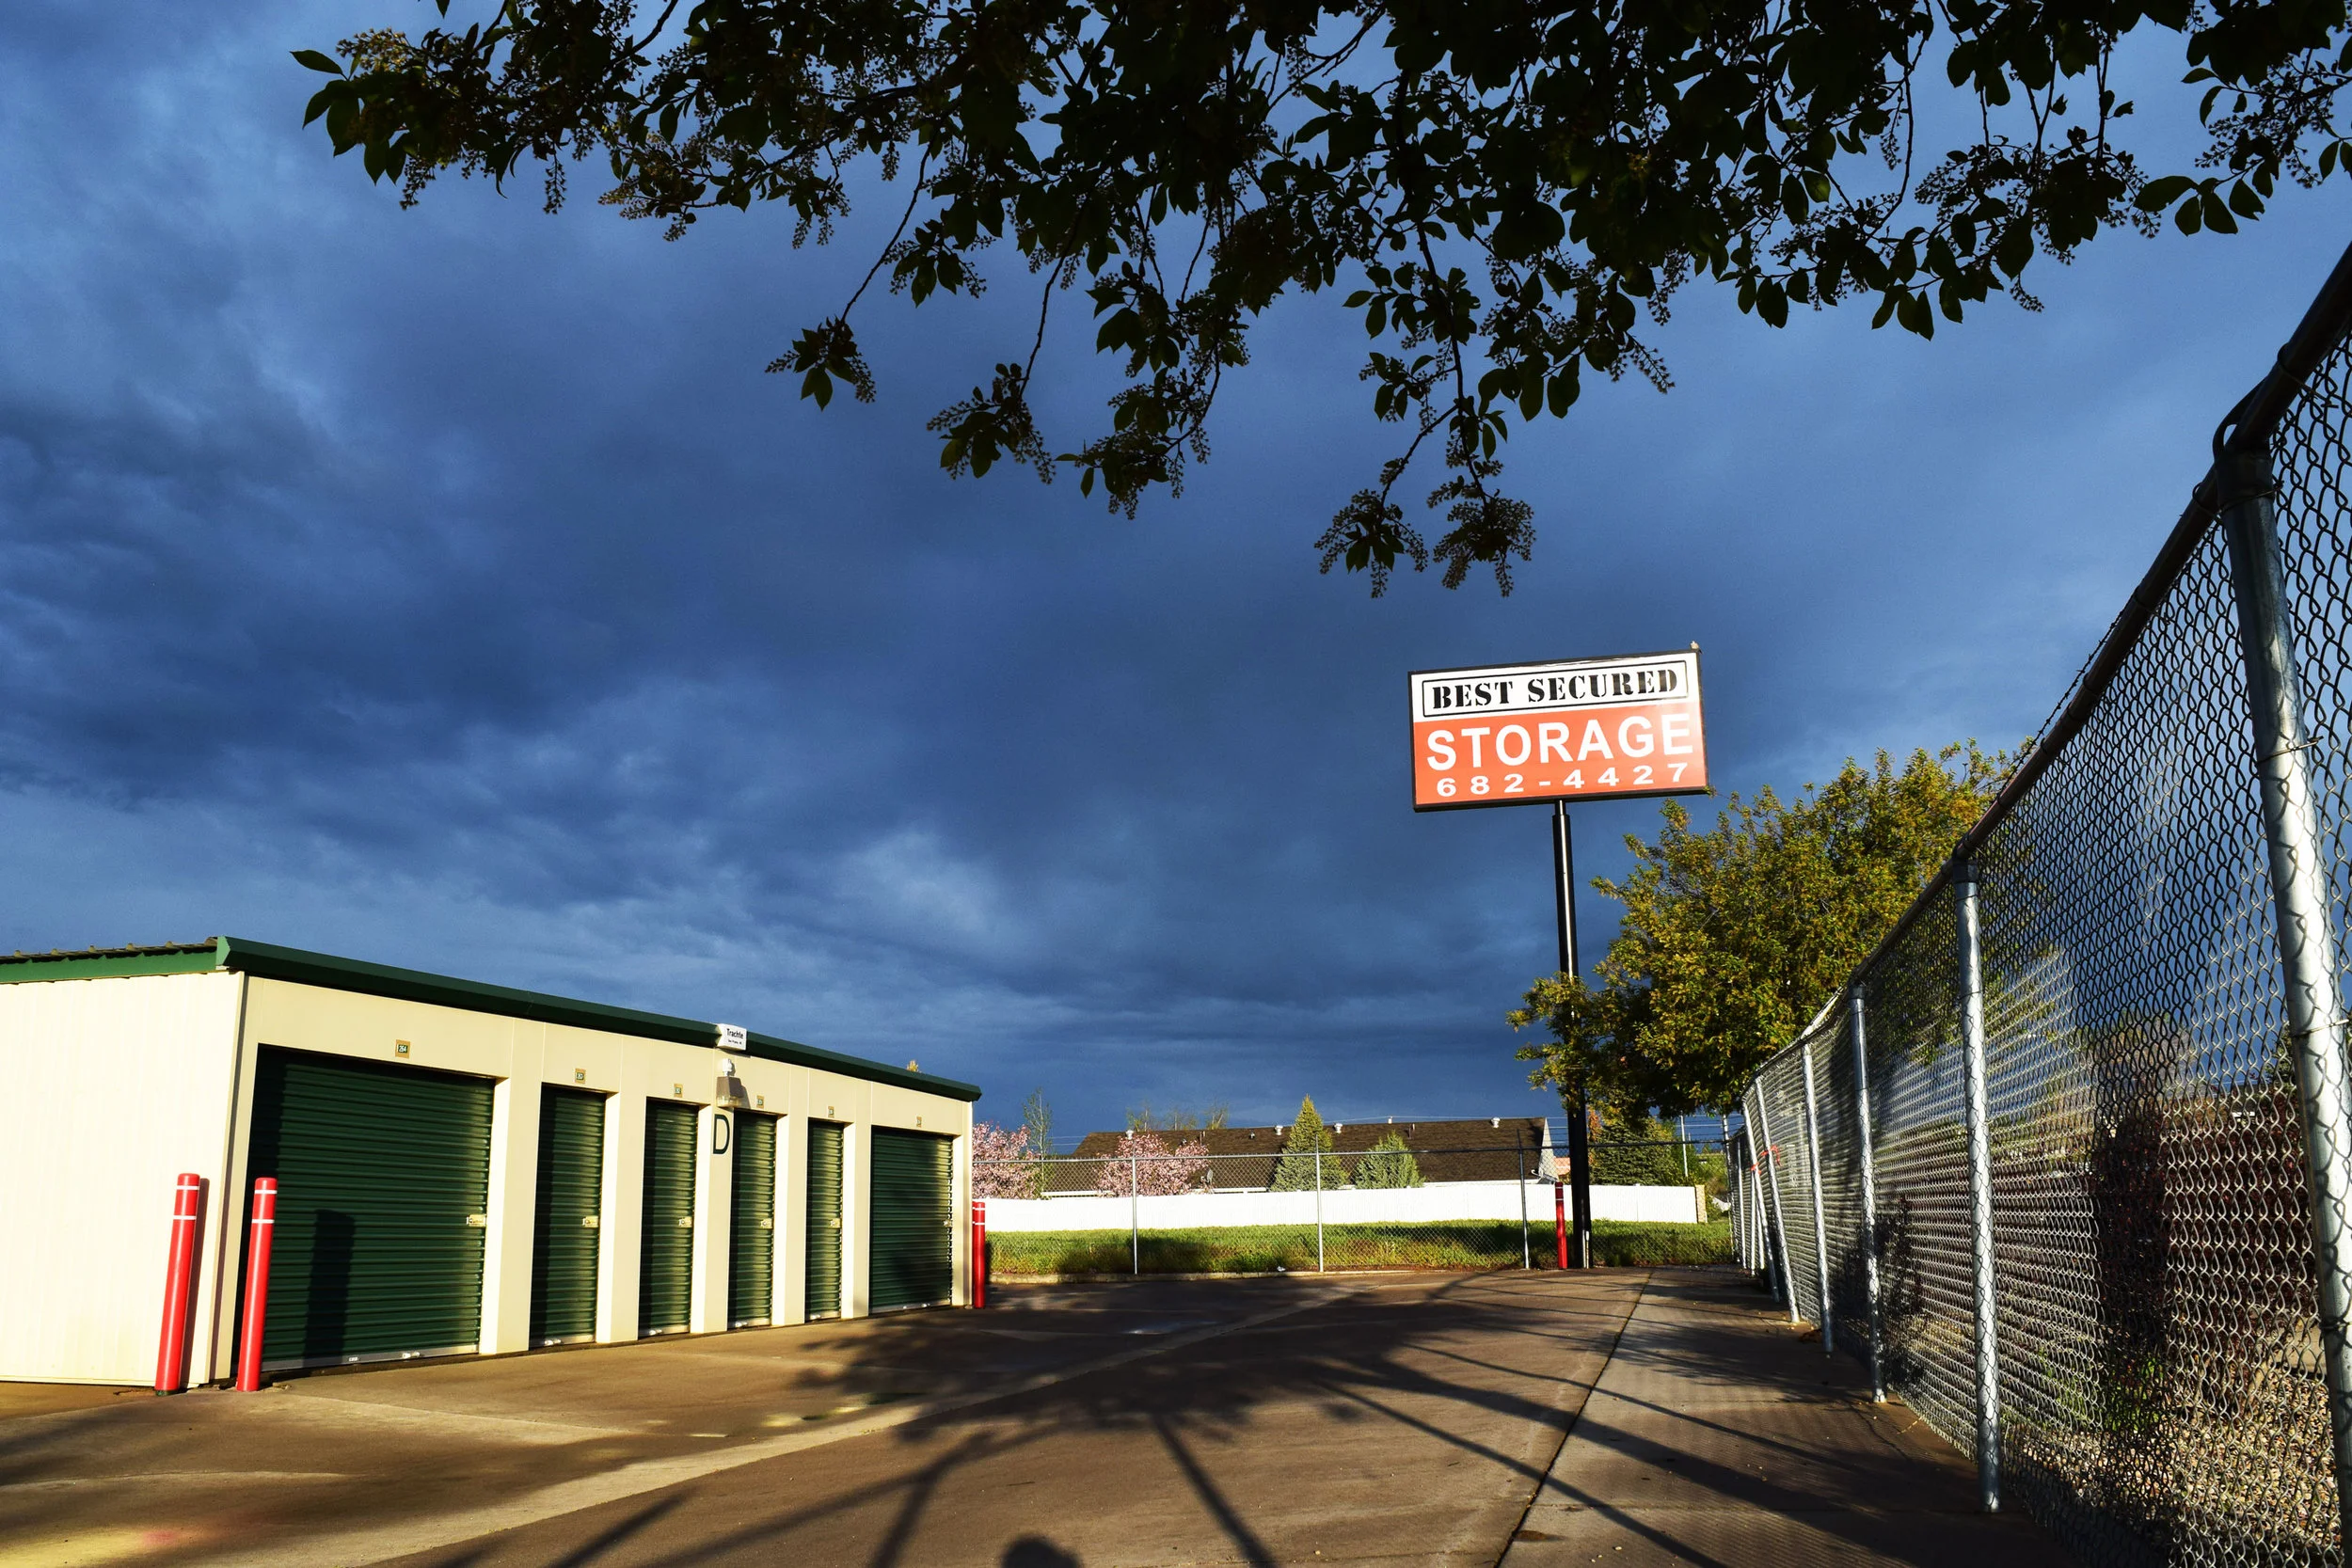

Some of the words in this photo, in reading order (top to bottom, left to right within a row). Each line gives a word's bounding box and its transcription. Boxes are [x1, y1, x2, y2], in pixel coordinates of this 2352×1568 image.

[1432, 681, 1514, 709] BEST
[1527, 669, 1677, 703] SECURED
[1426, 713, 1693, 771] STORAGE
[1436, 762, 1688, 798] 682-4427
[713, 1114, 730, 1155] D
